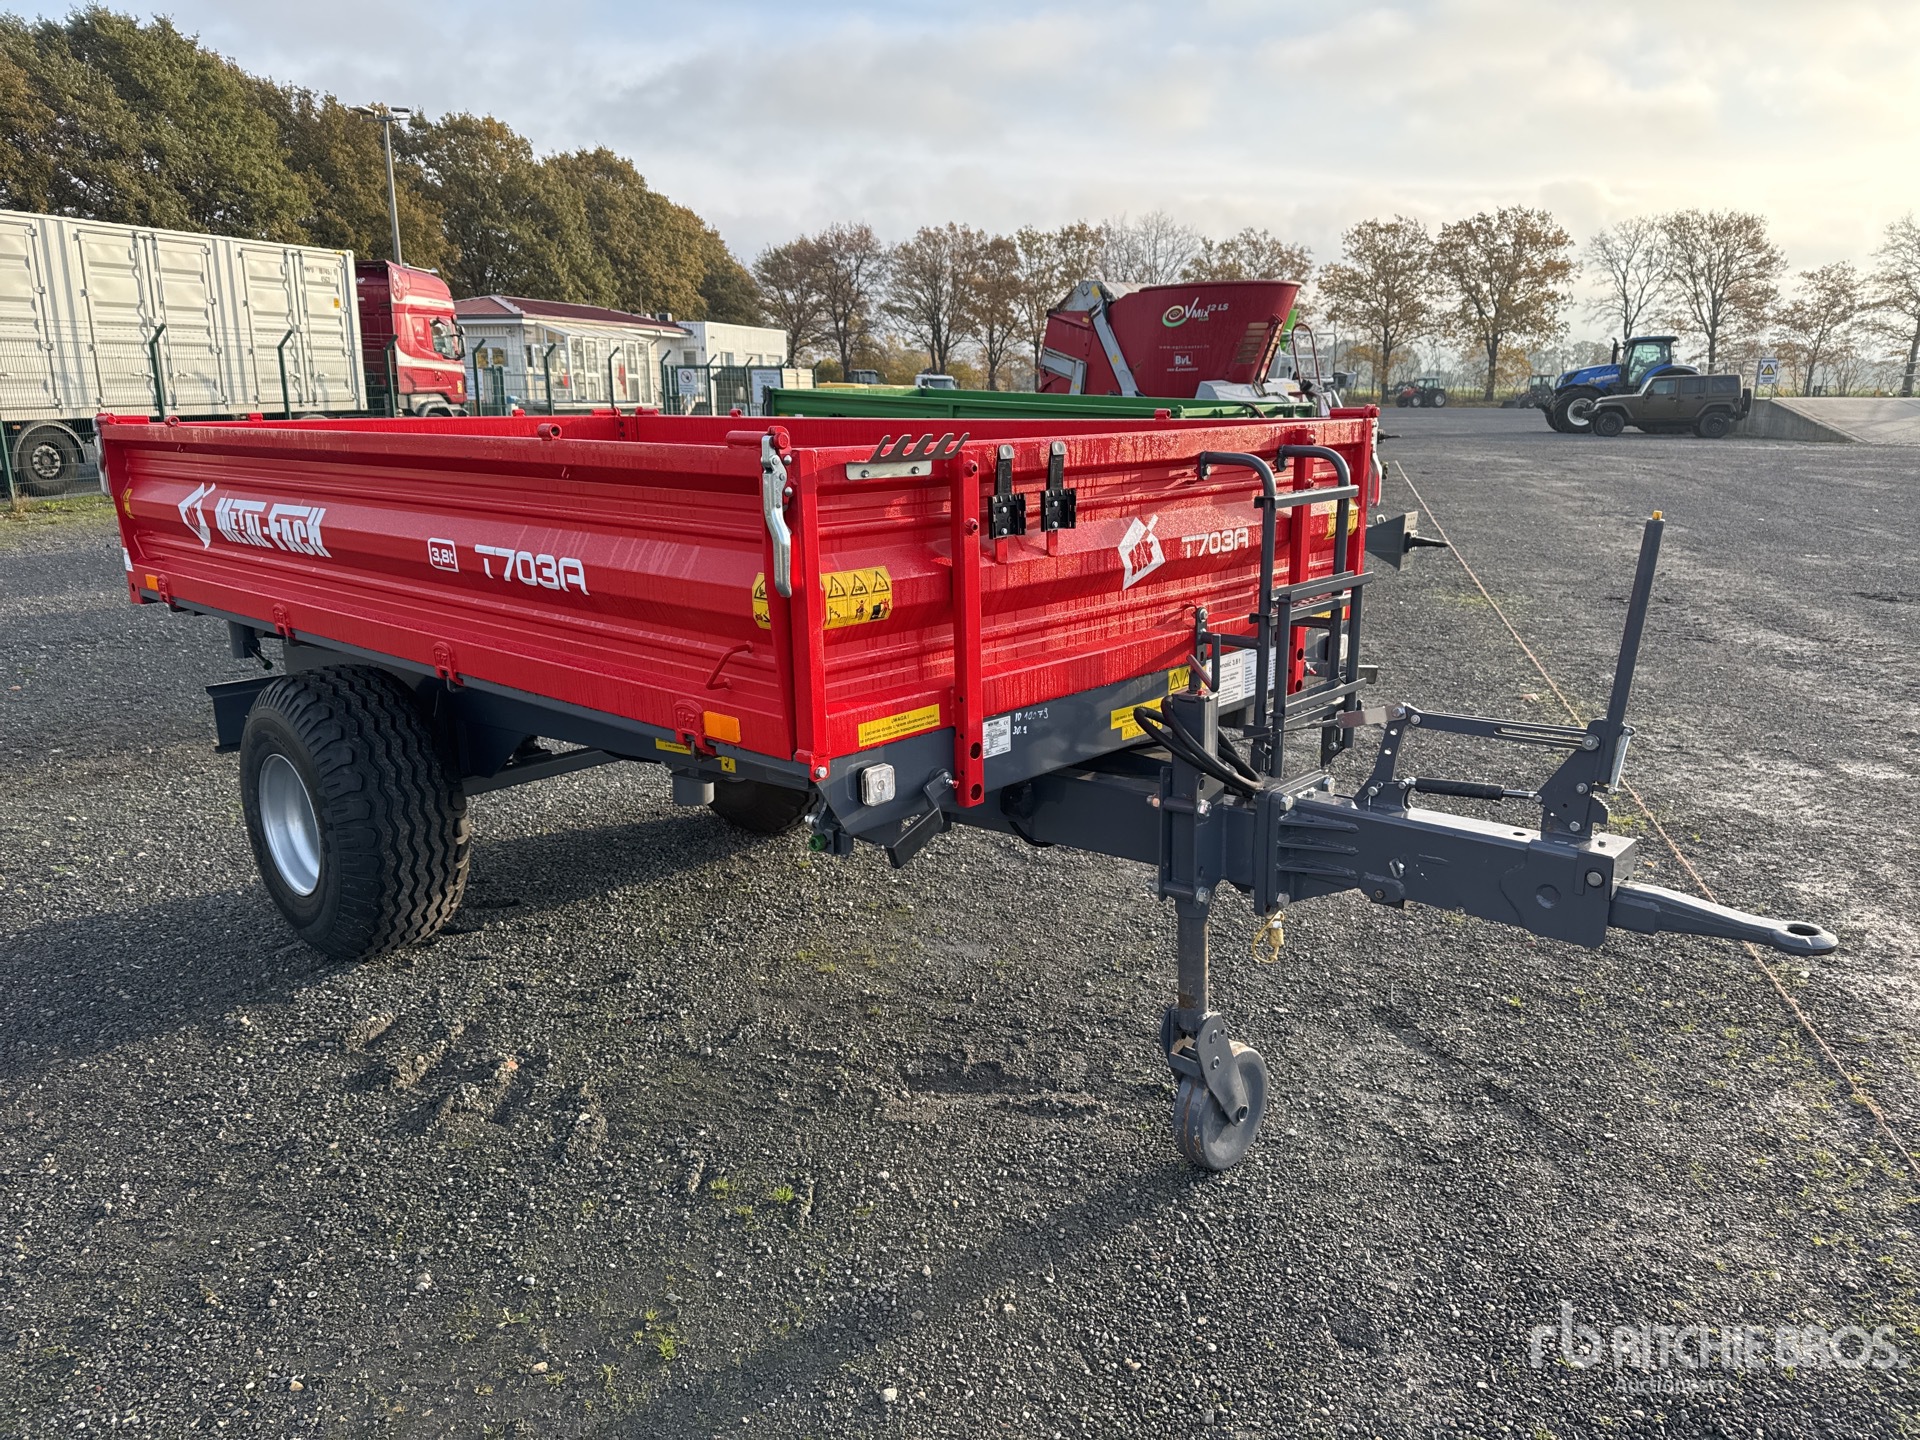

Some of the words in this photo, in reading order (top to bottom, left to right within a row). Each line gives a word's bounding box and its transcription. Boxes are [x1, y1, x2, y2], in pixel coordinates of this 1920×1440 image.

[1218, 303, 1229, 311] LS
[1175, 355, 1192, 365] BvL
[1181, 527, 1249, 559] T703A
[474, 543, 590, 596] T703A
